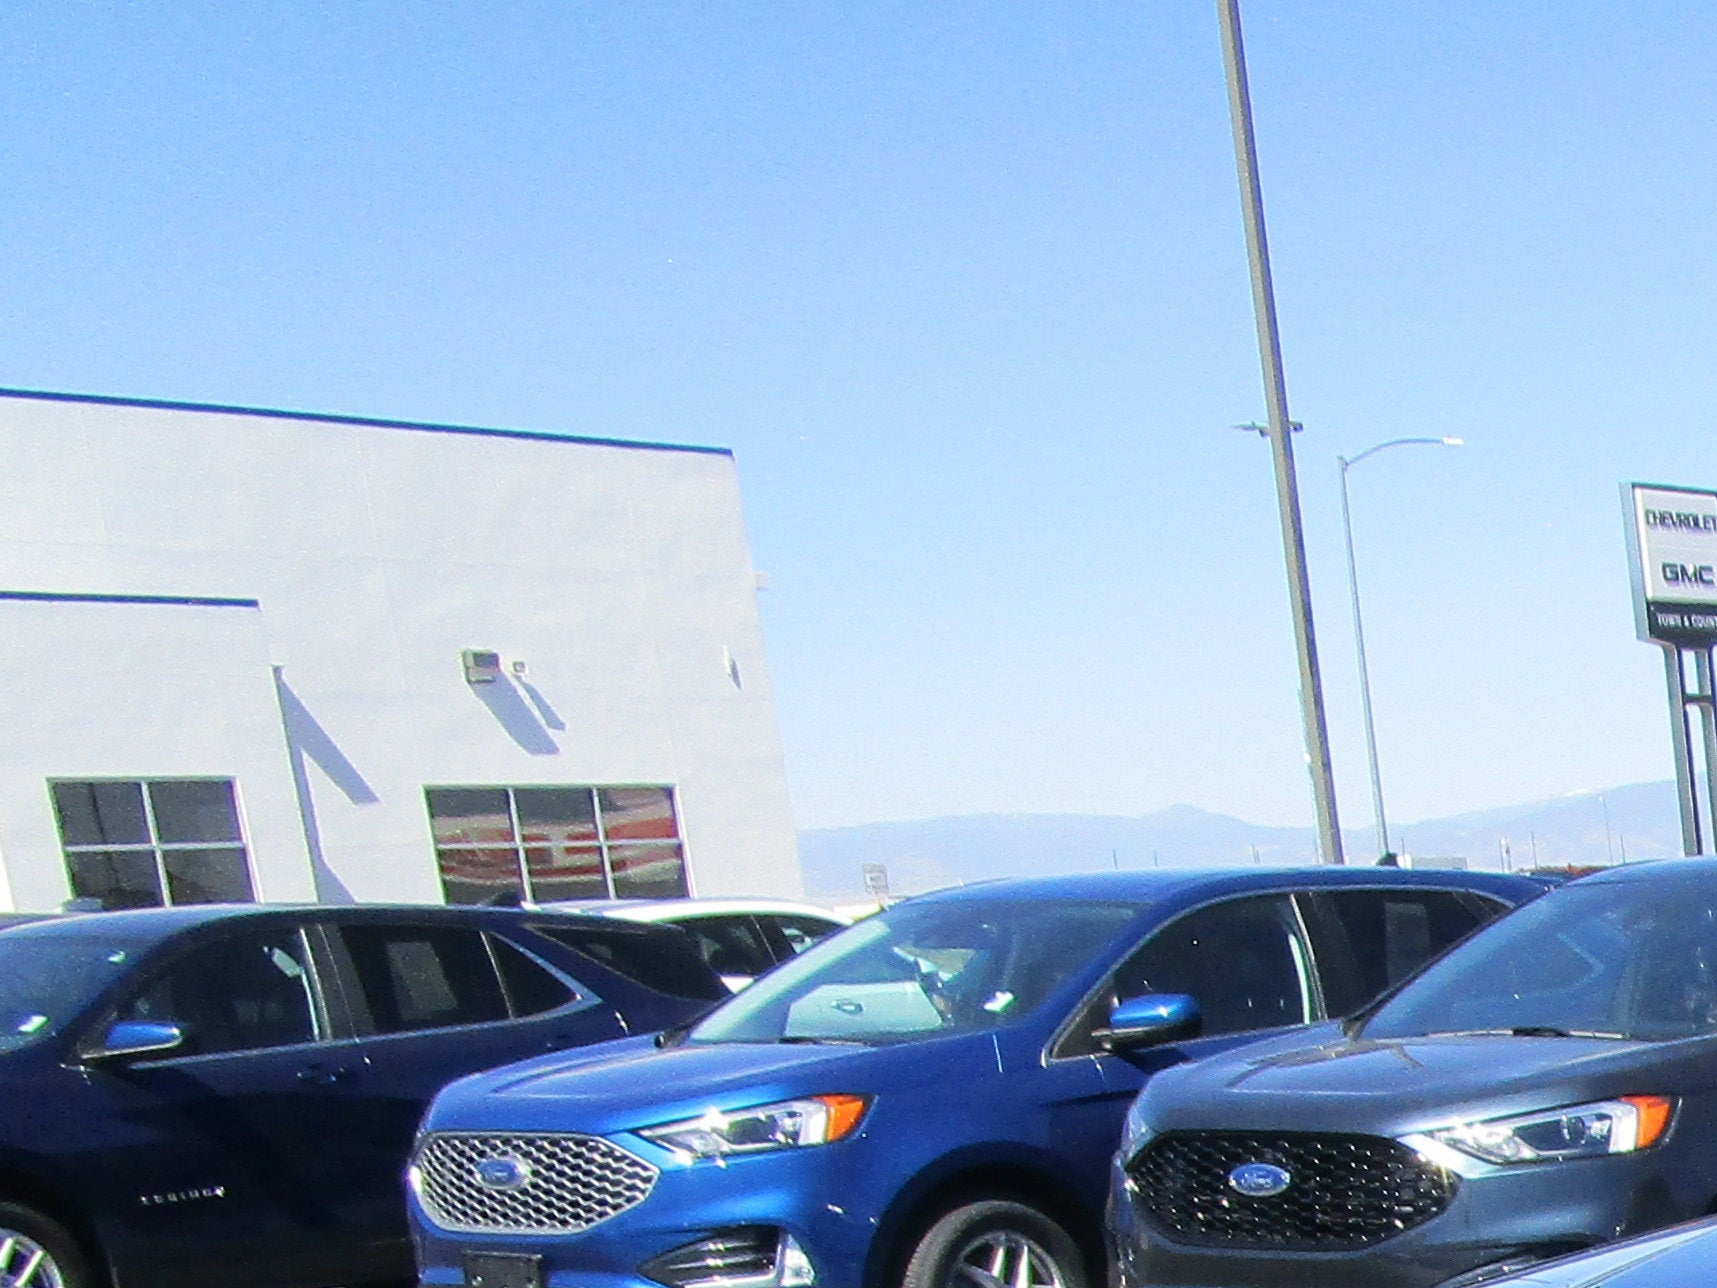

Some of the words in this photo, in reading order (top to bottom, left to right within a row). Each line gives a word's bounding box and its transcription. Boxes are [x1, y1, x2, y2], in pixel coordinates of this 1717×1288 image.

[1645, 508, 1717, 533] CHEVROLET
[1661, 562, 1715, 585] GMC
[1657, 613, 1682, 628] TOWN
